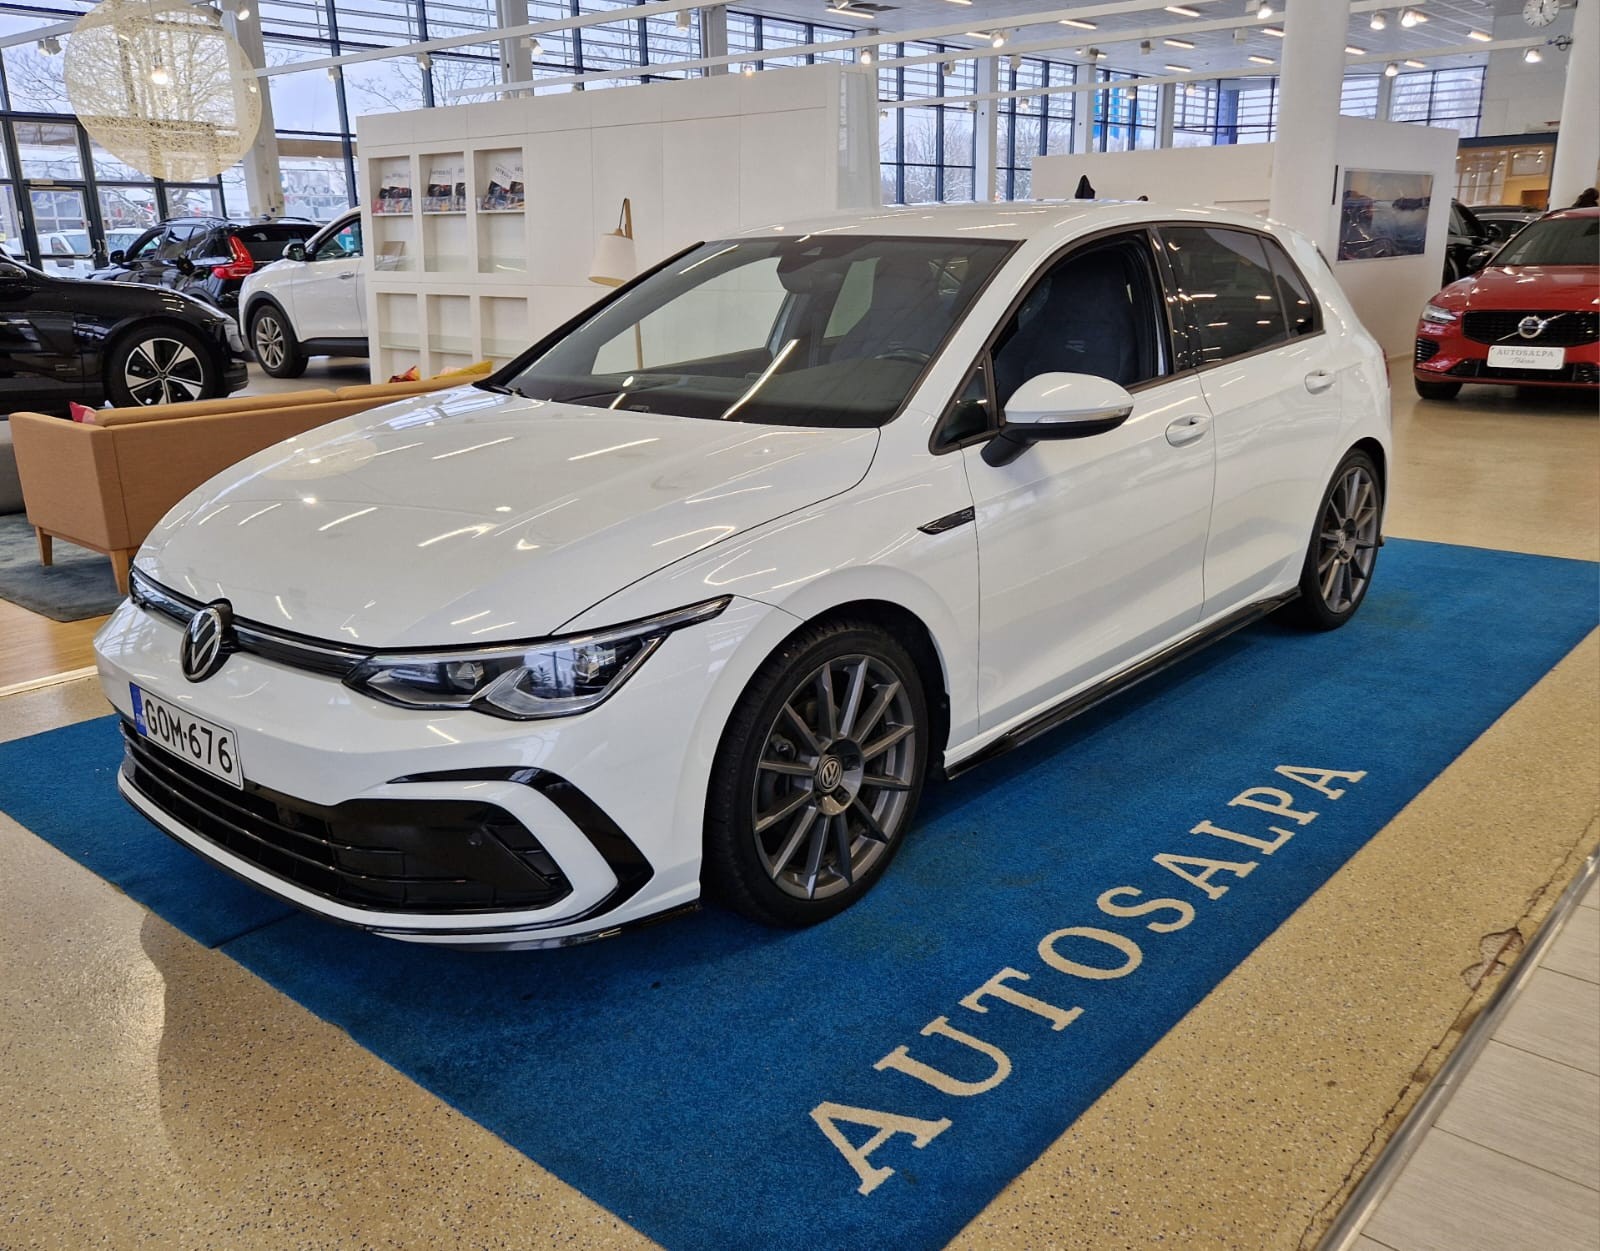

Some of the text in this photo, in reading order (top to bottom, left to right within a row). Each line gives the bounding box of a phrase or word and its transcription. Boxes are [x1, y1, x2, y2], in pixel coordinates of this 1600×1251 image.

[1496, 348, 1555, 358] AUTOSALPA
[145, 699, 233, 774] GOM-676
[810, 763, 1366, 1196] AUTOSALPA
